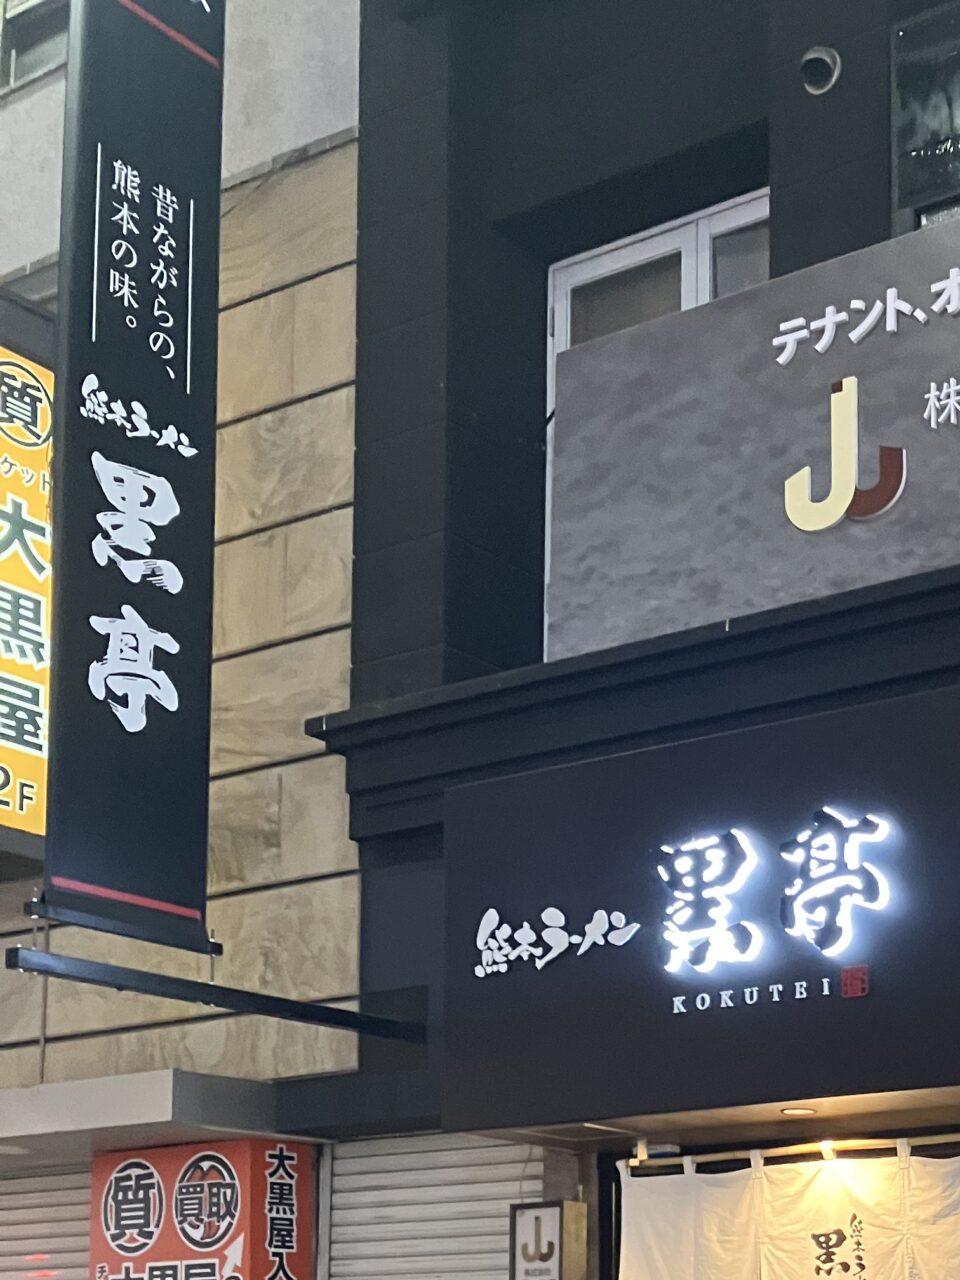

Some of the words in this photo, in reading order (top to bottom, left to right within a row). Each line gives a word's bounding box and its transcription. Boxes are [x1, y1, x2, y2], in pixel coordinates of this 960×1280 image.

[109, 159, 141, 329] 熊本の味。
[150, 184, 178, 380] 昔ながらの、
[88, 451, 184, 733] 黒亭
[656, 805, 892, 974] 黒亭
[671, 977, 832, 1014] KOKUTEI
[110, 1170, 156, 1244] 質
